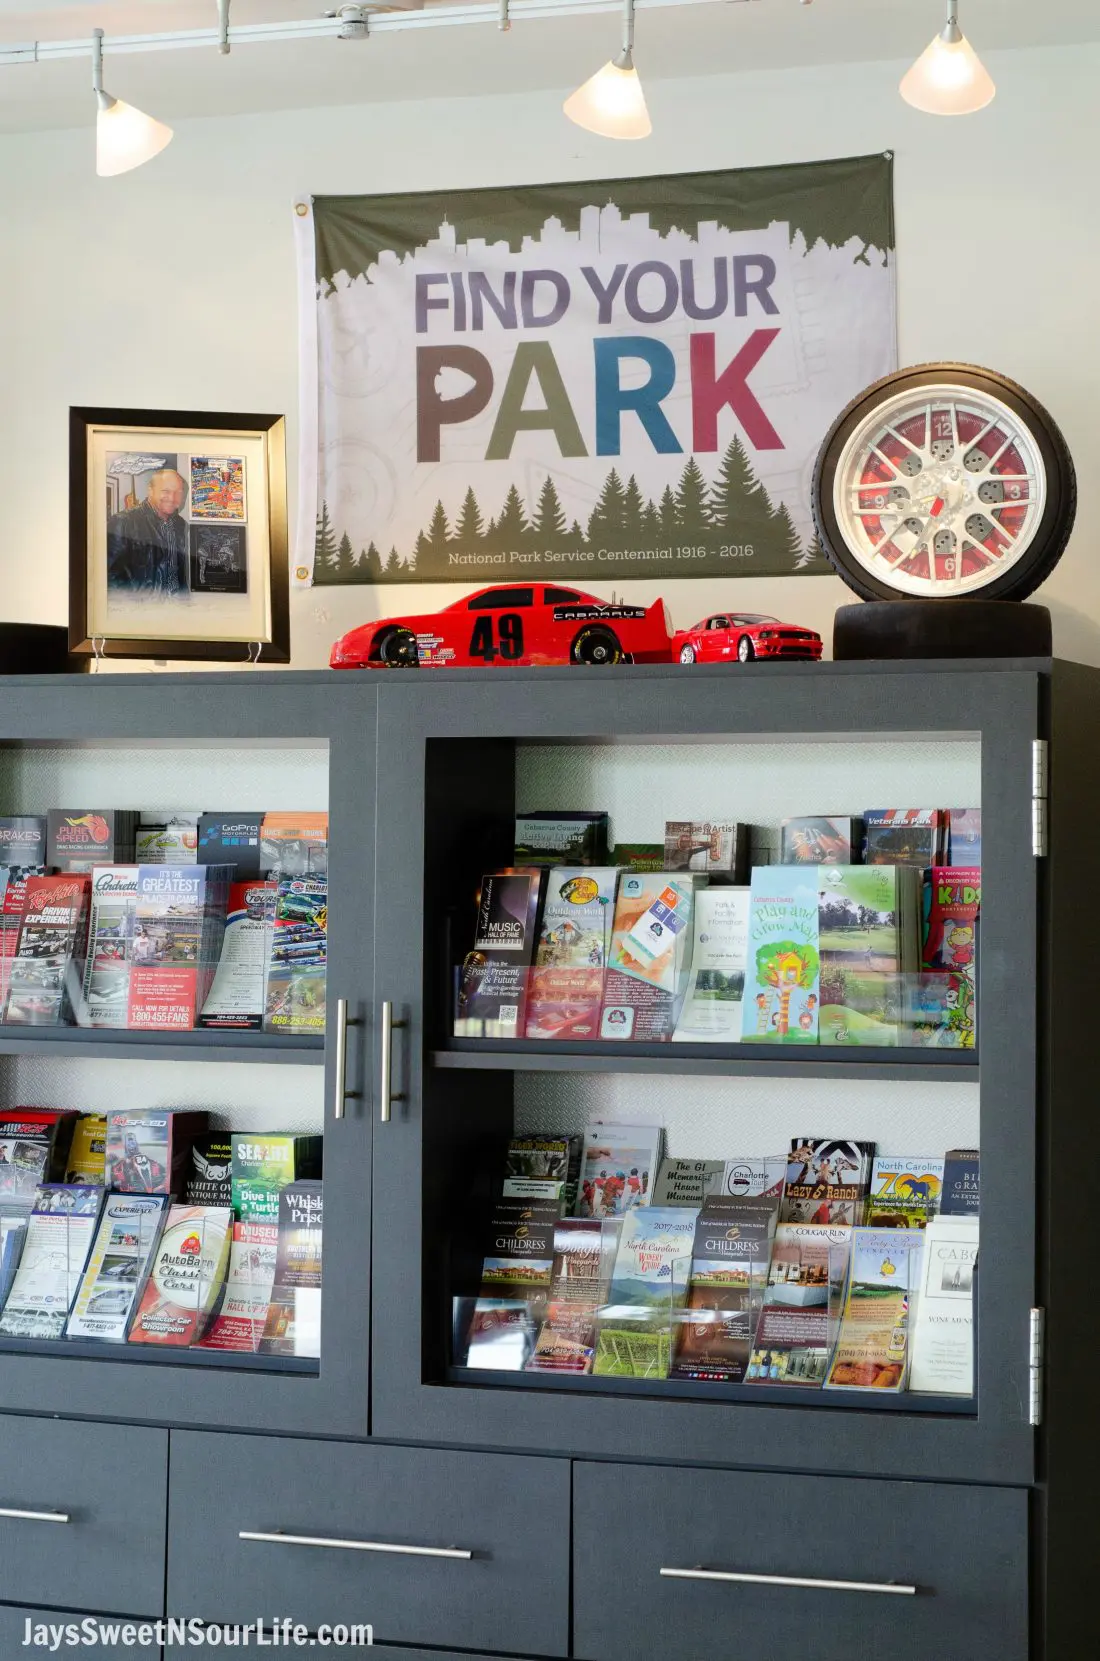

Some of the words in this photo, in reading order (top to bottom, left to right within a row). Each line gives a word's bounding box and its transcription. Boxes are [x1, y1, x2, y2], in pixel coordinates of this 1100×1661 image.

[414, 270, 571, 333] FIND
[580, 254, 780, 325] YOUR
[416, 328, 786, 463] PARK
[934, 422, 953, 437] 12
[1010, 485, 1021, 499] 3
[874, 495, 885, 508] 9
[448, 552, 507, 565] National
[509, 552, 541, 563] Park
[544, 550, 595, 562] Service
[598, 548, 672, 561] Centennial
[676, 547, 706, 559] 1916
[720, 544, 754, 557] 2016
[944, 558, 955, 572] 6
[554, 610, 646, 619] CABARRUS
[469, 613, 524, 661] 49
[59, 826, 88, 835] PURE
[712, 825, 736, 834] Artist
[55, 834, 90, 843] SPEED
[95, 874, 138, 891] Andretti
[143, 879, 200, 892] GREATEST
[42, 907, 77, 916] DRIVING
[755, 904, 786, 922] Play
[790, 904, 817, 920] and
[25, 915, 76, 924] EXPERIENCE
[489, 922, 521, 932] MUSIC
[788, 921, 819, 942] Map
[491, 968, 520, 977] Present,
[237, 1144, 261, 1160] SEA
[676, 1162, 690, 1171] The
[695, 1162, 706, 1172] GI
[877, 1161, 903, 1170] North
[905, 1162, 942, 1171] Carolina
[734, 1171, 770, 1179] Charlotte
[186, 1181, 218, 1190] WHITE
[673, 1182, 700, 1191] House
[876, 1171, 943, 1200] ZOO
[185, 1191, 218, 1200] ANTIQUE
[219, 1192, 232, 1200] MA
[241, 1191, 265, 1201] Dive
[666, 1191, 703, 1201] Museum
[786, 1184, 812, 1199] Lazy
[812, 1184, 826, 1199] 5
[826, 1186, 857, 1200] Ranch
[250, 1202, 280, 1212] Turtle
[873, 1200, 896, 1208] Experience
[114, 1206, 153, 1215] EXPERIENCE
[654, 1222, 693, 1233] 2017-2018
[795, 1227, 827, 1236] COUGAR
[829, 1228, 846, 1237] RUN
[495, 1238, 546, 1250] CHILDRESS
[624, 1240, 648, 1252] North
[648, 1241, 680, 1253] Carolina
[705, 1241, 760, 1252] CHILDRESS
[160, 1253, 214, 1268] AutoBarn
[163, 1279, 195, 1291] Cars
[226, 1303, 245, 1312] HALL
[141, 1312, 177, 1324] Collector
[177, 1316, 192, 1324] Car
[142, 1322, 185, 1333] Showroom
